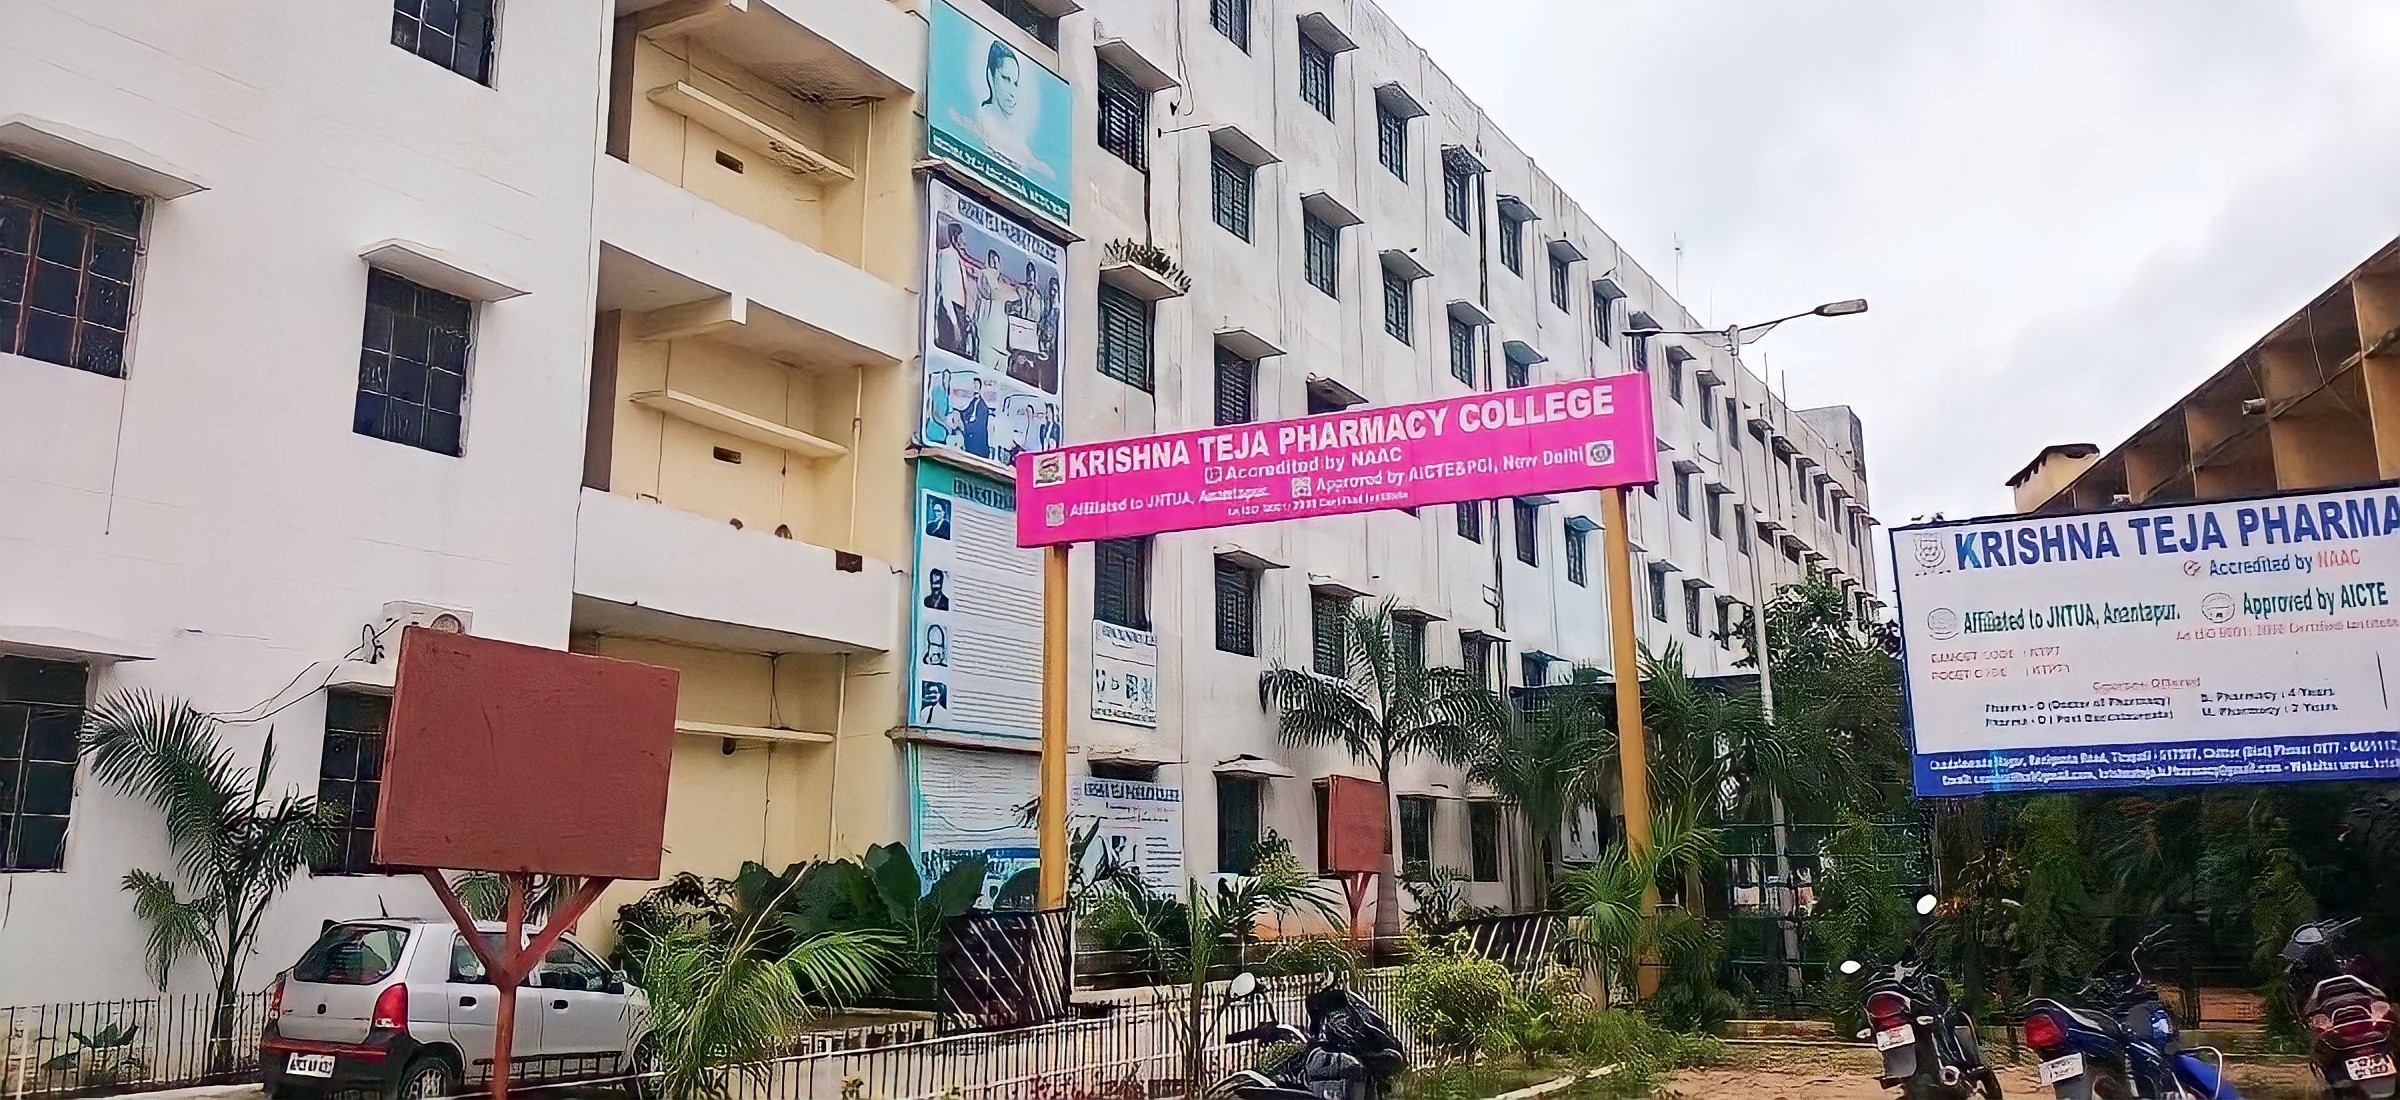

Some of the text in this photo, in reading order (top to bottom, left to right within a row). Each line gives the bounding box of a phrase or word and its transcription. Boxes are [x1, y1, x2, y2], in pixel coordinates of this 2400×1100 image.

[1068, 384, 1616, 479] KRISHNA TEJA PHARMACY COLLEGE
[1325, 454, 1345, 472] by
[1351, 446, 1402, 467] NAAC
[1954, 495, 2400, 571] KRISHNA TEJA PHARMA
[2209, 553, 2291, 577] Accredited
[2295, 553, 2313, 574] by
[2242, 581, 2389, 620] Approved by AICTE
[1963, 608, 2025, 635] Affiliated
[2029, 608, 2043, 630] to
